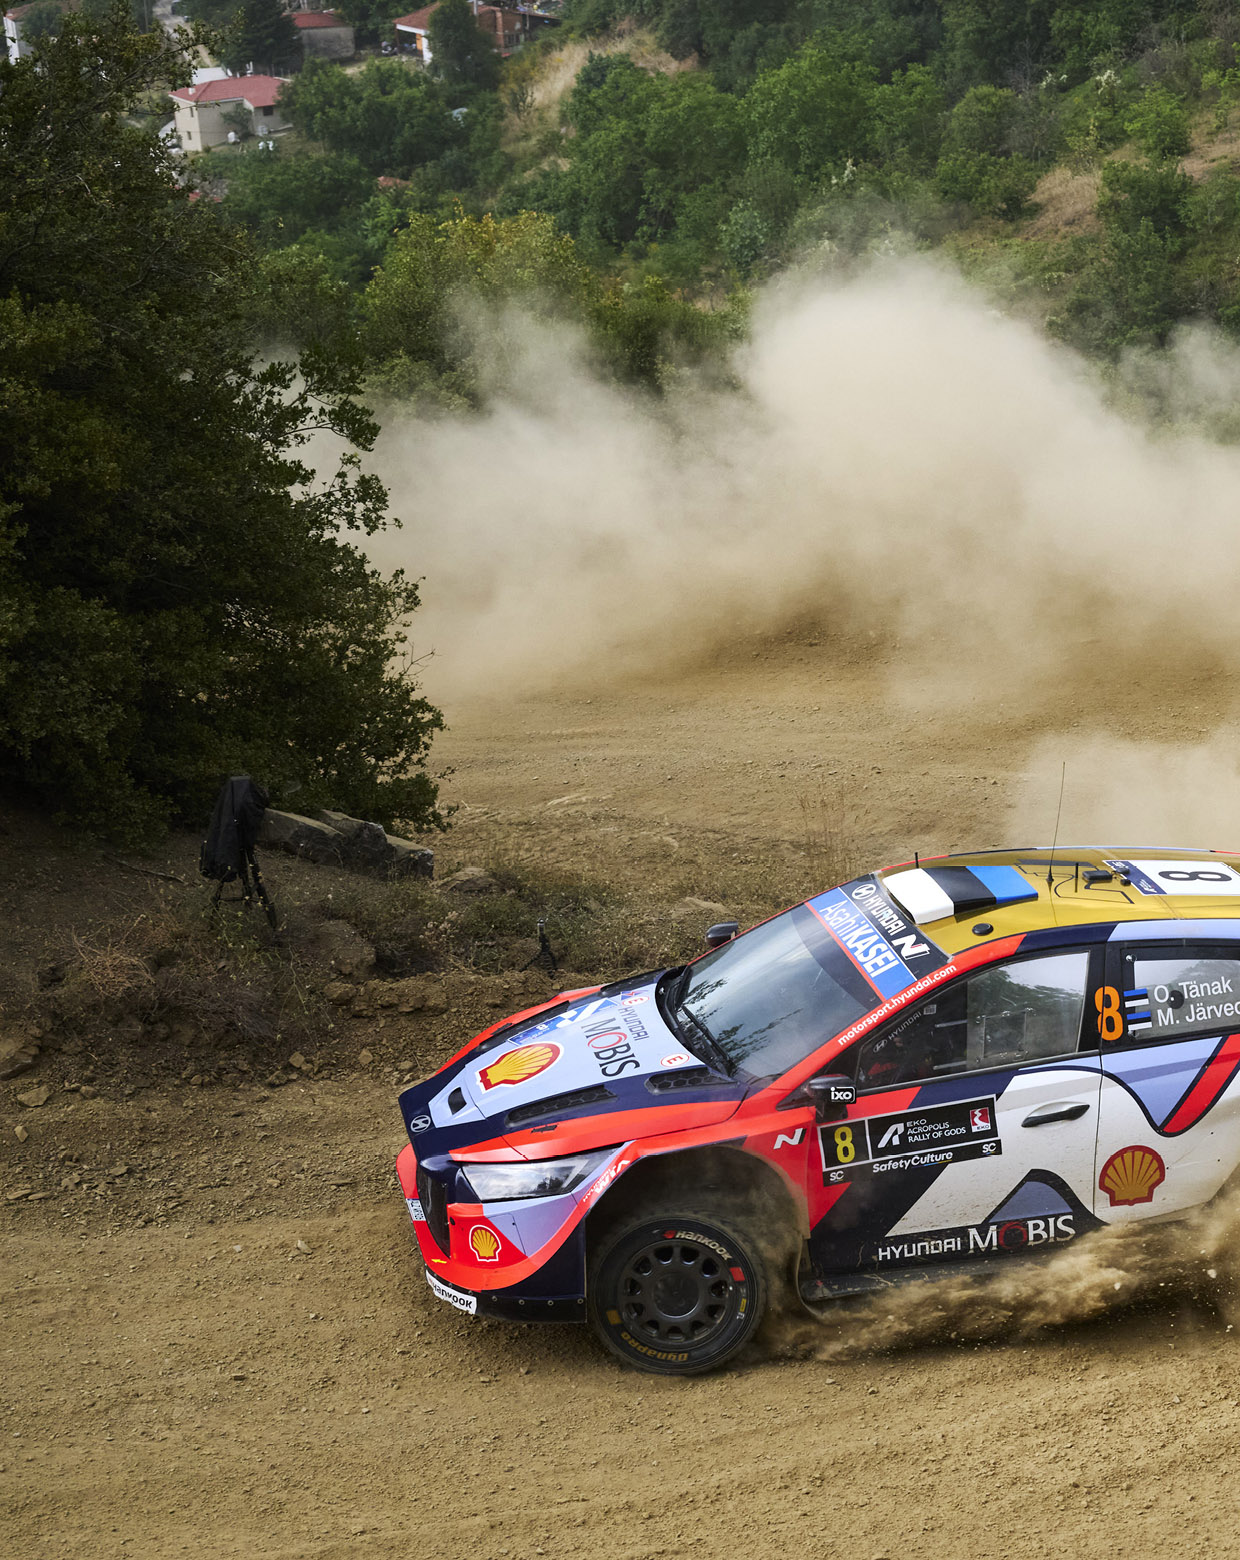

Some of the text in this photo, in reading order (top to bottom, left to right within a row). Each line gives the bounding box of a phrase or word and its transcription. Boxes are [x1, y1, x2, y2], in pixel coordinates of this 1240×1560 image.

[1158, 870, 1232, 882] 8
[863, 895, 907, 936] HYUNDAI
[1153, 976, 1233, 1003] O. Tänak
[837, 964, 957, 1046] motorsport.hyundai.com
[1094, 985, 1123, 1041] 8
[1157, 1008, 1180, 1027] M.
[618, 1007, 650, 1041] HYUNDAI
[888, 1011, 922, 1040] HYUNDAI
[581, 1017, 641, 1077] MOBIS
[830, 1086, 852, 1100] ixo
[906, 1118, 927, 1128] EKO
[907, 1121, 950, 1135] ACROPOLIS
[908, 1126, 967, 1144] RALLY OF GODS
[834, 1126, 855, 1164] 8
[829, 1170, 844, 1182] SC
[872, 1151, 954, 1174] SafetyCulture
[878, 1215, 1077, 1261] HYUNDAI MOBIS
